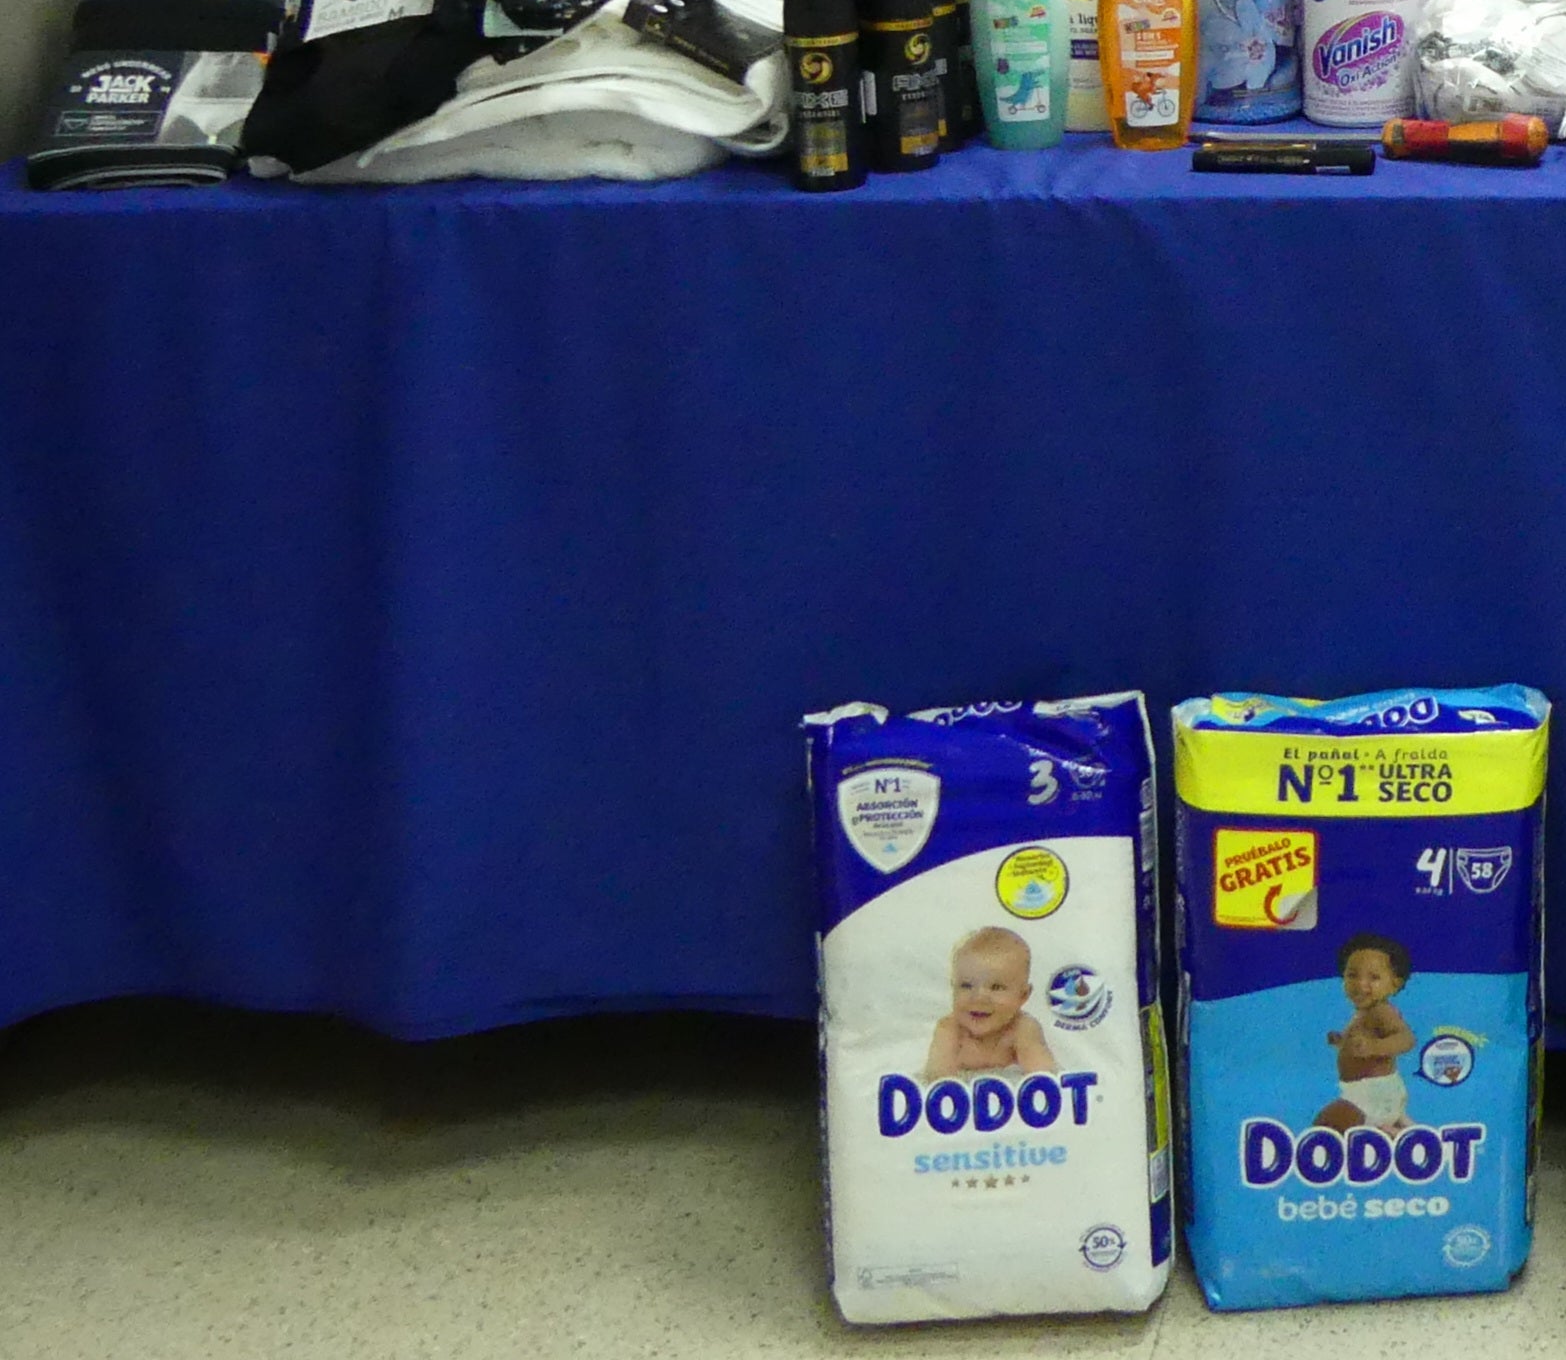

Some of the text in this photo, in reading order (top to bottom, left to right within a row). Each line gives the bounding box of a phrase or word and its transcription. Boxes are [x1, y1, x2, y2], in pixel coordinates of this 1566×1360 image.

[1319, 15, 1397, 79] Vanish
[90, 75, 157, 93] JACK
[1341, 54, 1397, 87] Oxi Action
[85, 92, 150, 104] PARKER
[1283, 747, 1300, 759] El
[1308, 748, 1360, 762] pañal
[1375, 749, 1386, 760] A
[1027, 759, 1059, 806] 3
[1379, 763, 1453, 780] ULTRA
[856, 797, 919, 812] ABSORCIÓN
[1378, 780, 1453, 803] SECO
[1224, 837, 1292, 868] PRUÉBALO
[1417, 847, 1447, 887] 4
[1219, 847, 1312, 893] GRATIS
[1471, 862, 1493, 880] 58
[877, 1071, 1099, 1139] DODOT
[913, 1140, 1068, 1175] sensitive
[1240, 1118, 1487, 1189] DODOT
[1277, 1193, 1450, 1222] bebé seco
